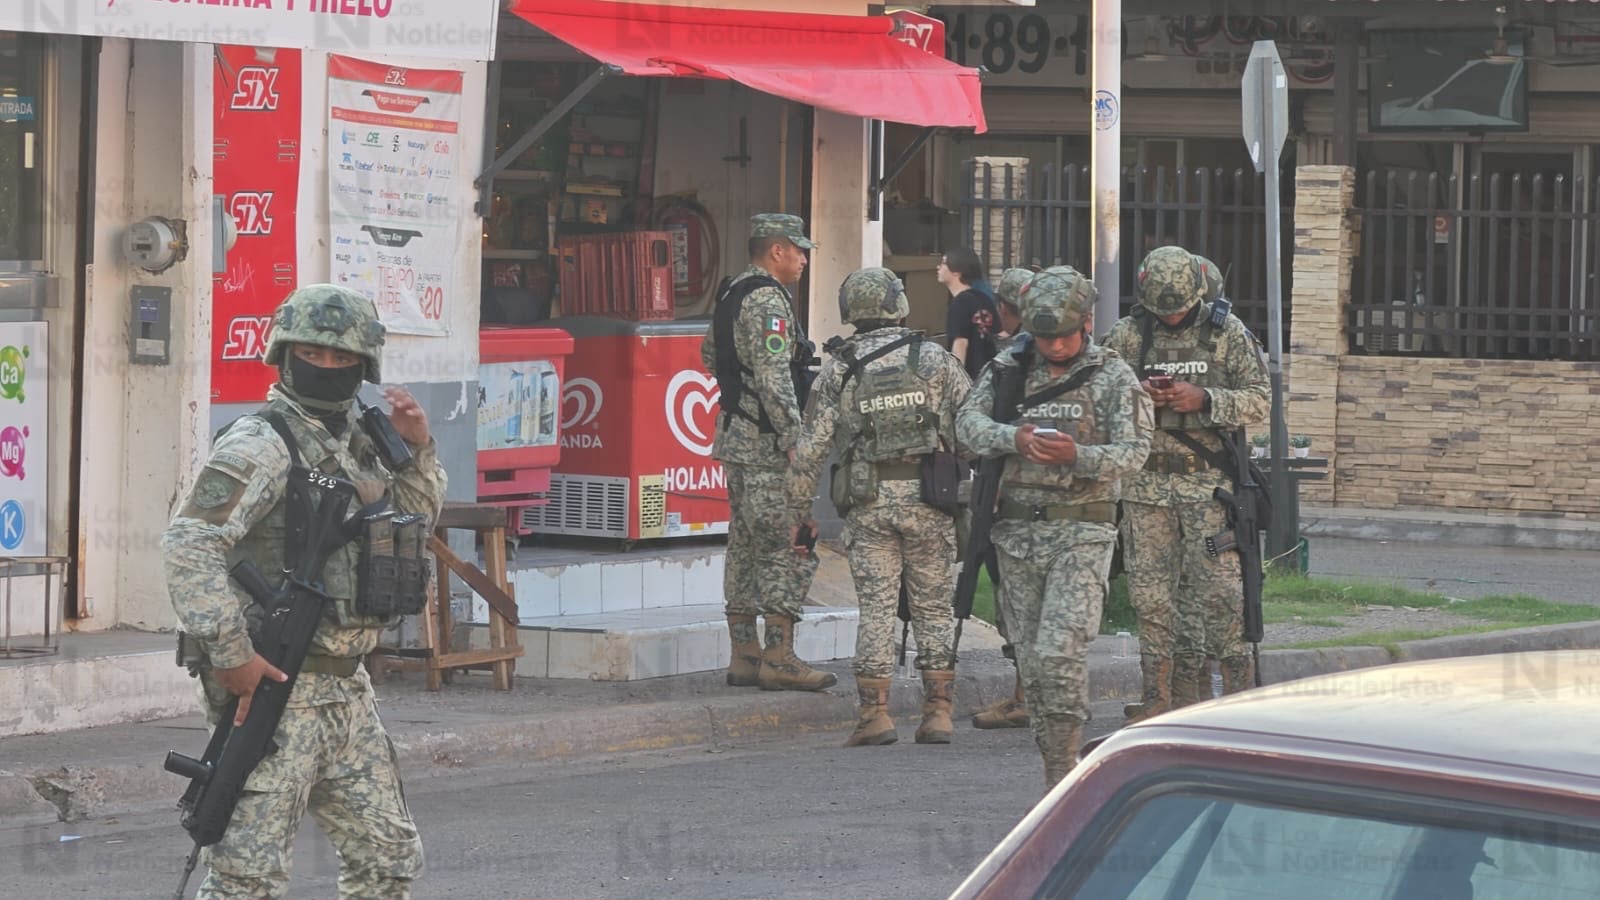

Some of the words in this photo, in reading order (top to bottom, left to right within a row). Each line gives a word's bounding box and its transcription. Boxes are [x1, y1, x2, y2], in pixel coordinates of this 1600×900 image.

[230, 66, 279, 111] SIX
[230, 191, 274, 236] SIX
[221, 315, 272, 362] SIX
[1, 361, 19, 386] Ca
[860, 391, 925, 414] EJÉRCITO
[1, 440, 19, 465] Mg
[664, 465, 728, 491] HOLAN
[4, 511, 17, 538] K
